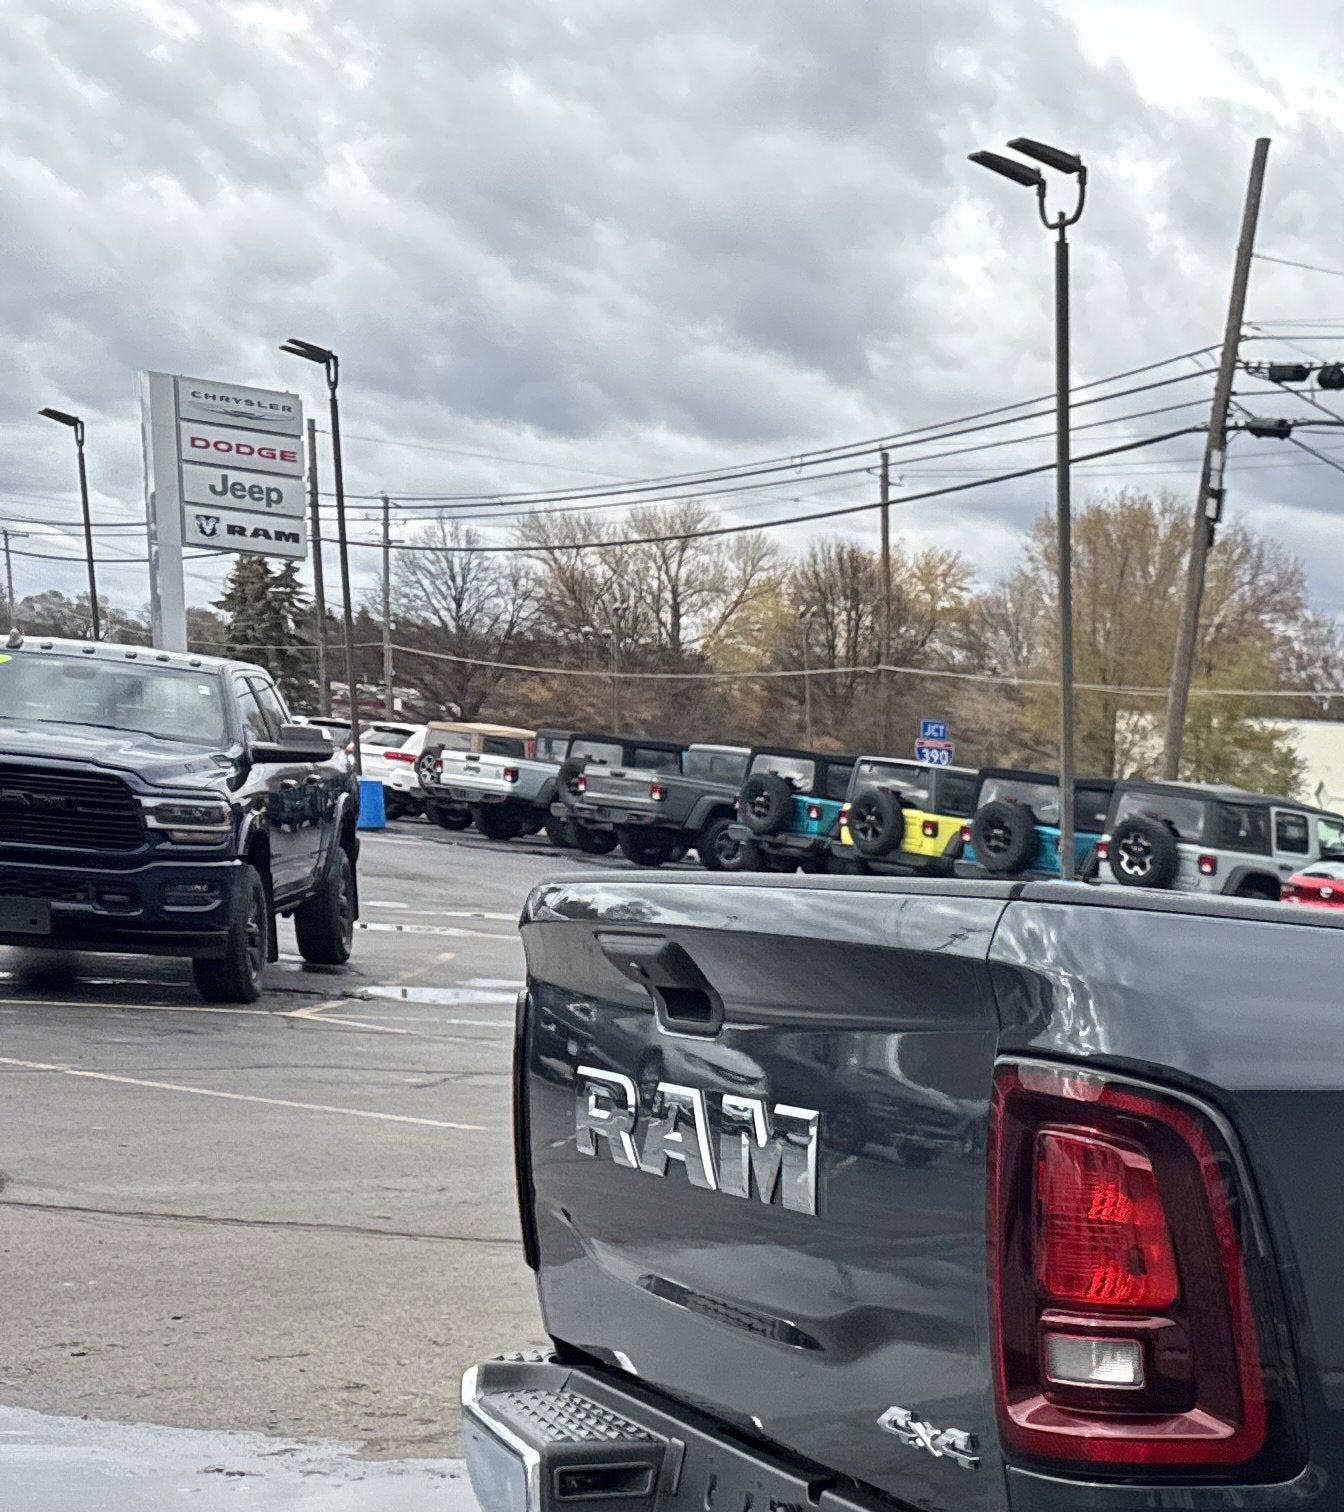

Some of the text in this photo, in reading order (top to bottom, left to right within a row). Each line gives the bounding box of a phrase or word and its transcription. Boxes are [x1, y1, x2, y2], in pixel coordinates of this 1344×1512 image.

[191, 391, 293, 413] CHRYSLER
[190, 436, 298, 463] DODGE
[208, 473, 284, 508] Jeep
[226, 523, 300, 544] RAM
[924, 724, 945, 737] JCT
[921, 748, 950, 766] 390
[575, 1064, 823, 1216] RAM
